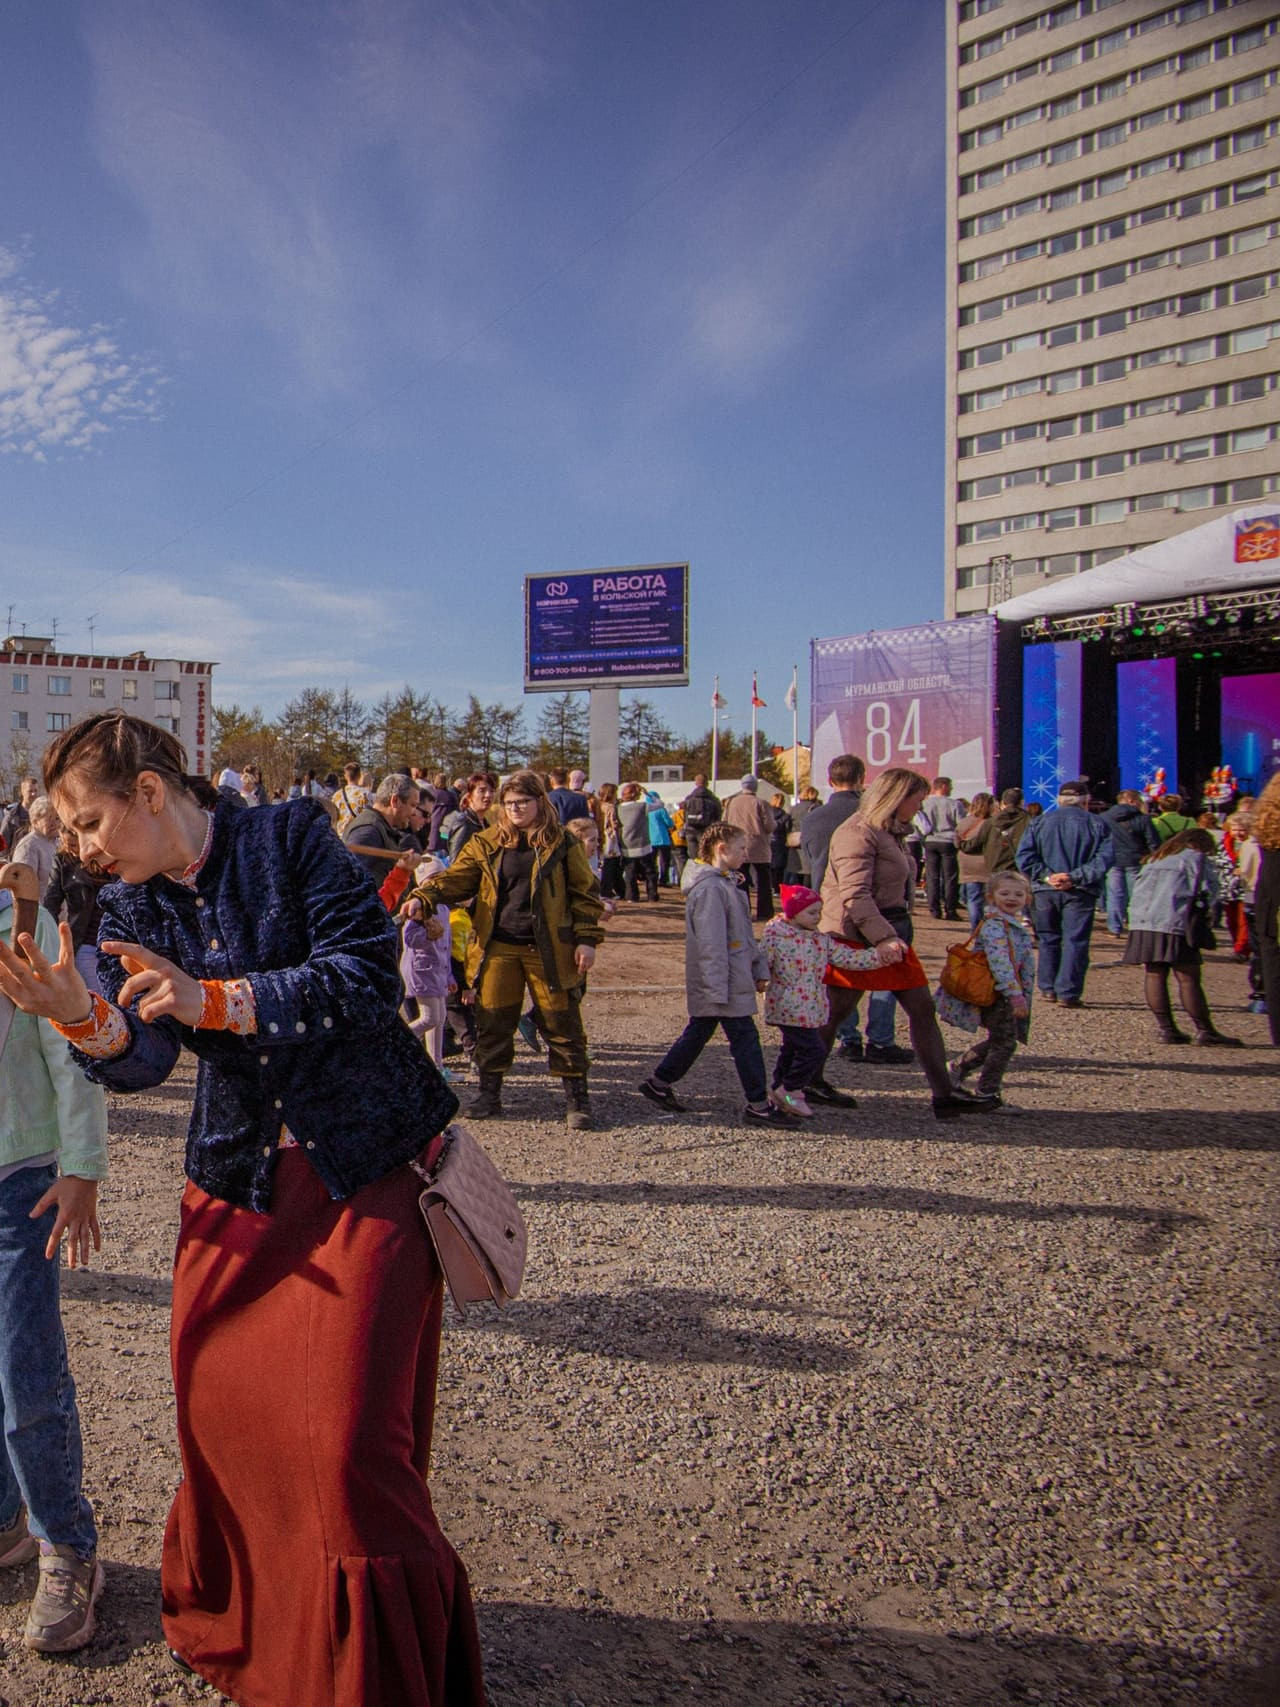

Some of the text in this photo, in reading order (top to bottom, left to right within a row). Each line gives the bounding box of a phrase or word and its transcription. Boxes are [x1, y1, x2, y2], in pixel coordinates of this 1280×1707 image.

[593, 574, 666, 593] РАБОТА
[601, 590, 647, 602] КОЛЬСКОЙ
[648, 588, 667, 598] ГМК
[845, 674, 951, 698] МУРМАНСКОЙ ОБЛАСТИ
[866, 699, 927, 766] 84
[196, 750, 204, 774] ЦЕН
